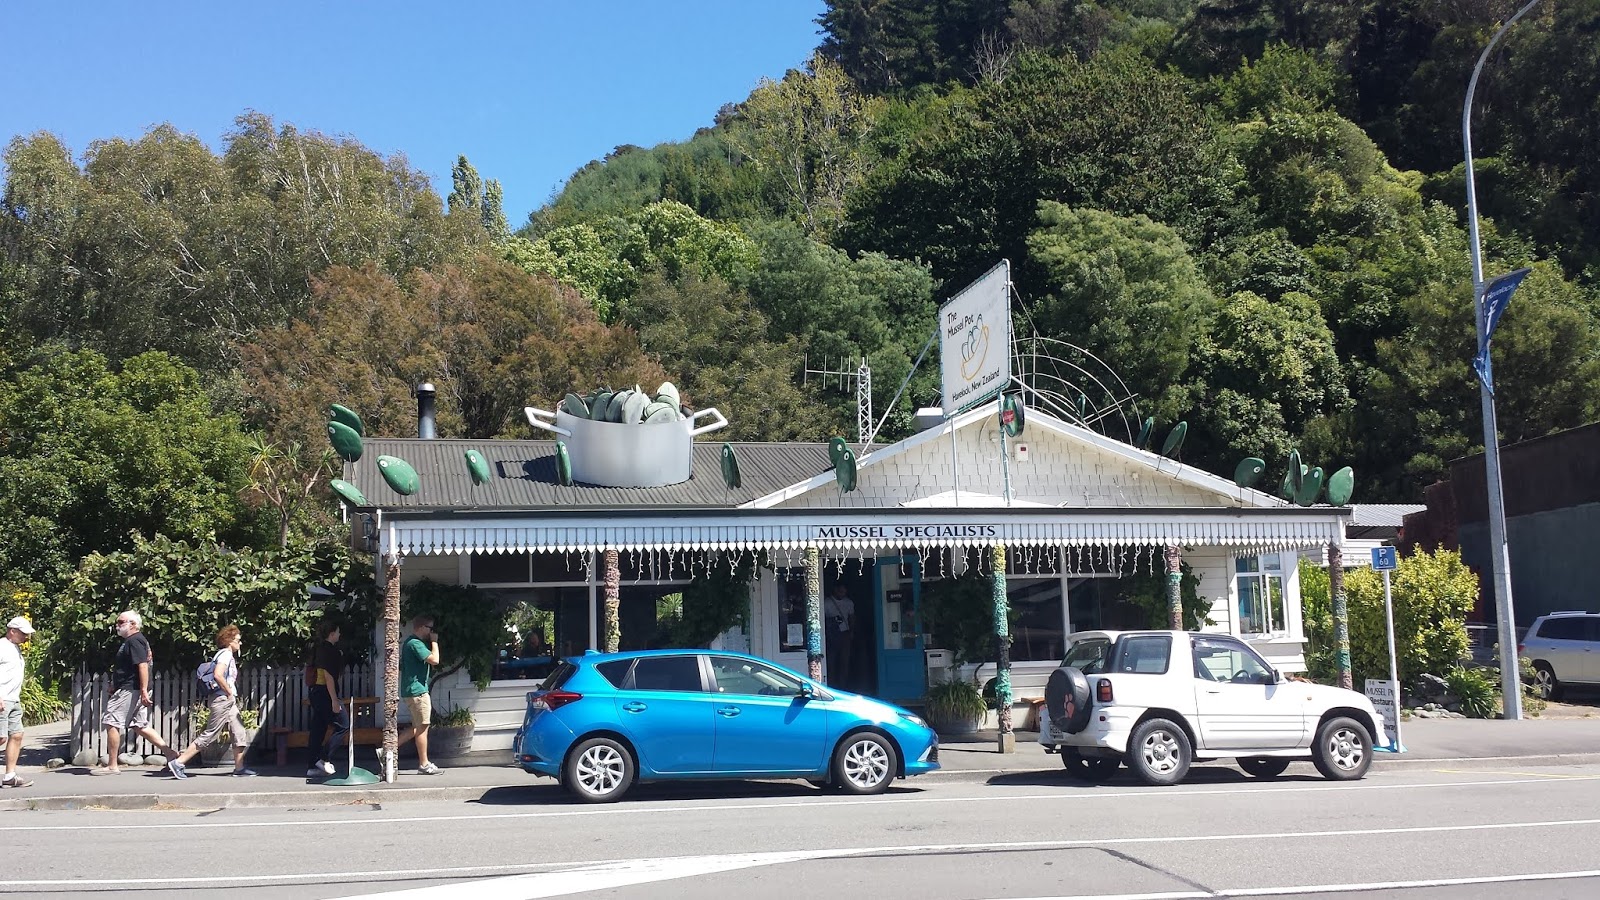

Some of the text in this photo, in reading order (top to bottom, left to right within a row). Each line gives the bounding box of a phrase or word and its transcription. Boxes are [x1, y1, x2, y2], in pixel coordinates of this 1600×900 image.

[947, 312, 957, 324] The
[947, 314, 974, 339] Mussel Pot
[971, 380, 982, 392] New
[982, 367, 1000, 386] Zealand
[818, 525, 996, 538] MUSSEL SPECIALISTS
[1378, 548, 1387, 558] P
[1379, 557, 1389, 565] 60
[1365, 687, 1387, 697] MUSSEL
